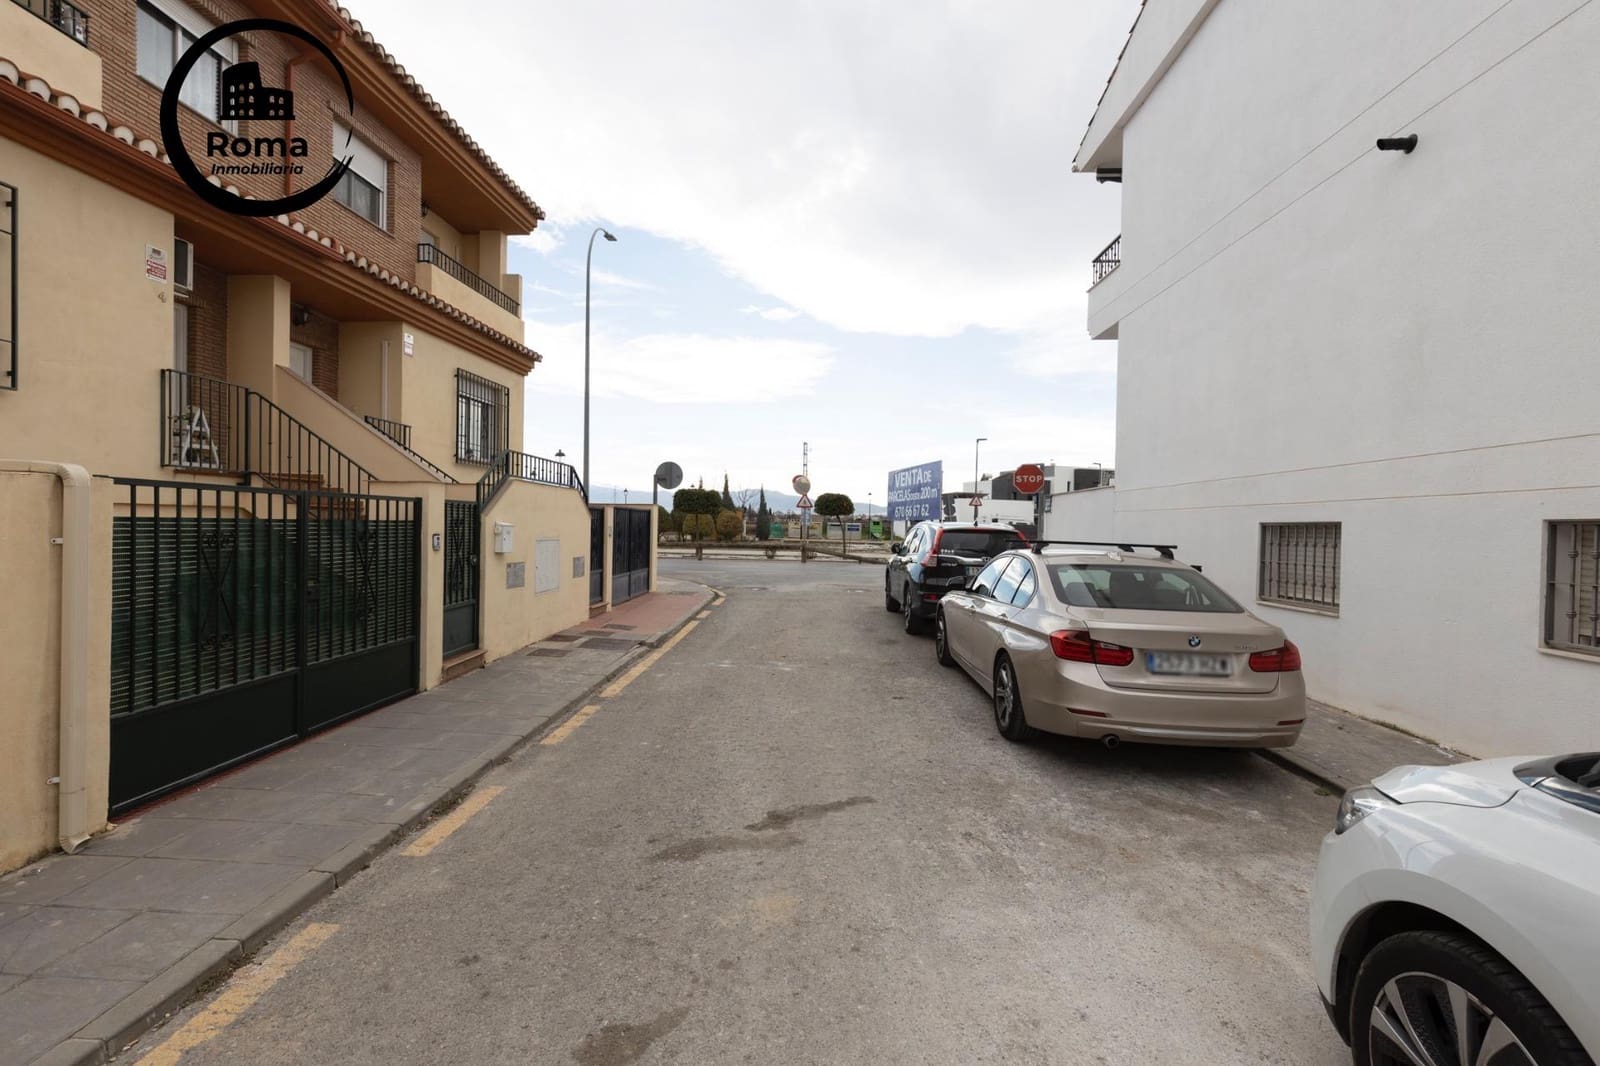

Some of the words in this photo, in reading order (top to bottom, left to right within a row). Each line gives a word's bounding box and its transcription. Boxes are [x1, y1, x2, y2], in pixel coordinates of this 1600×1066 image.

[895, 468, 923, 488] VENTA
[923, 470, 932, 483] DE
[1016, 475, 1042, 483] STOP
